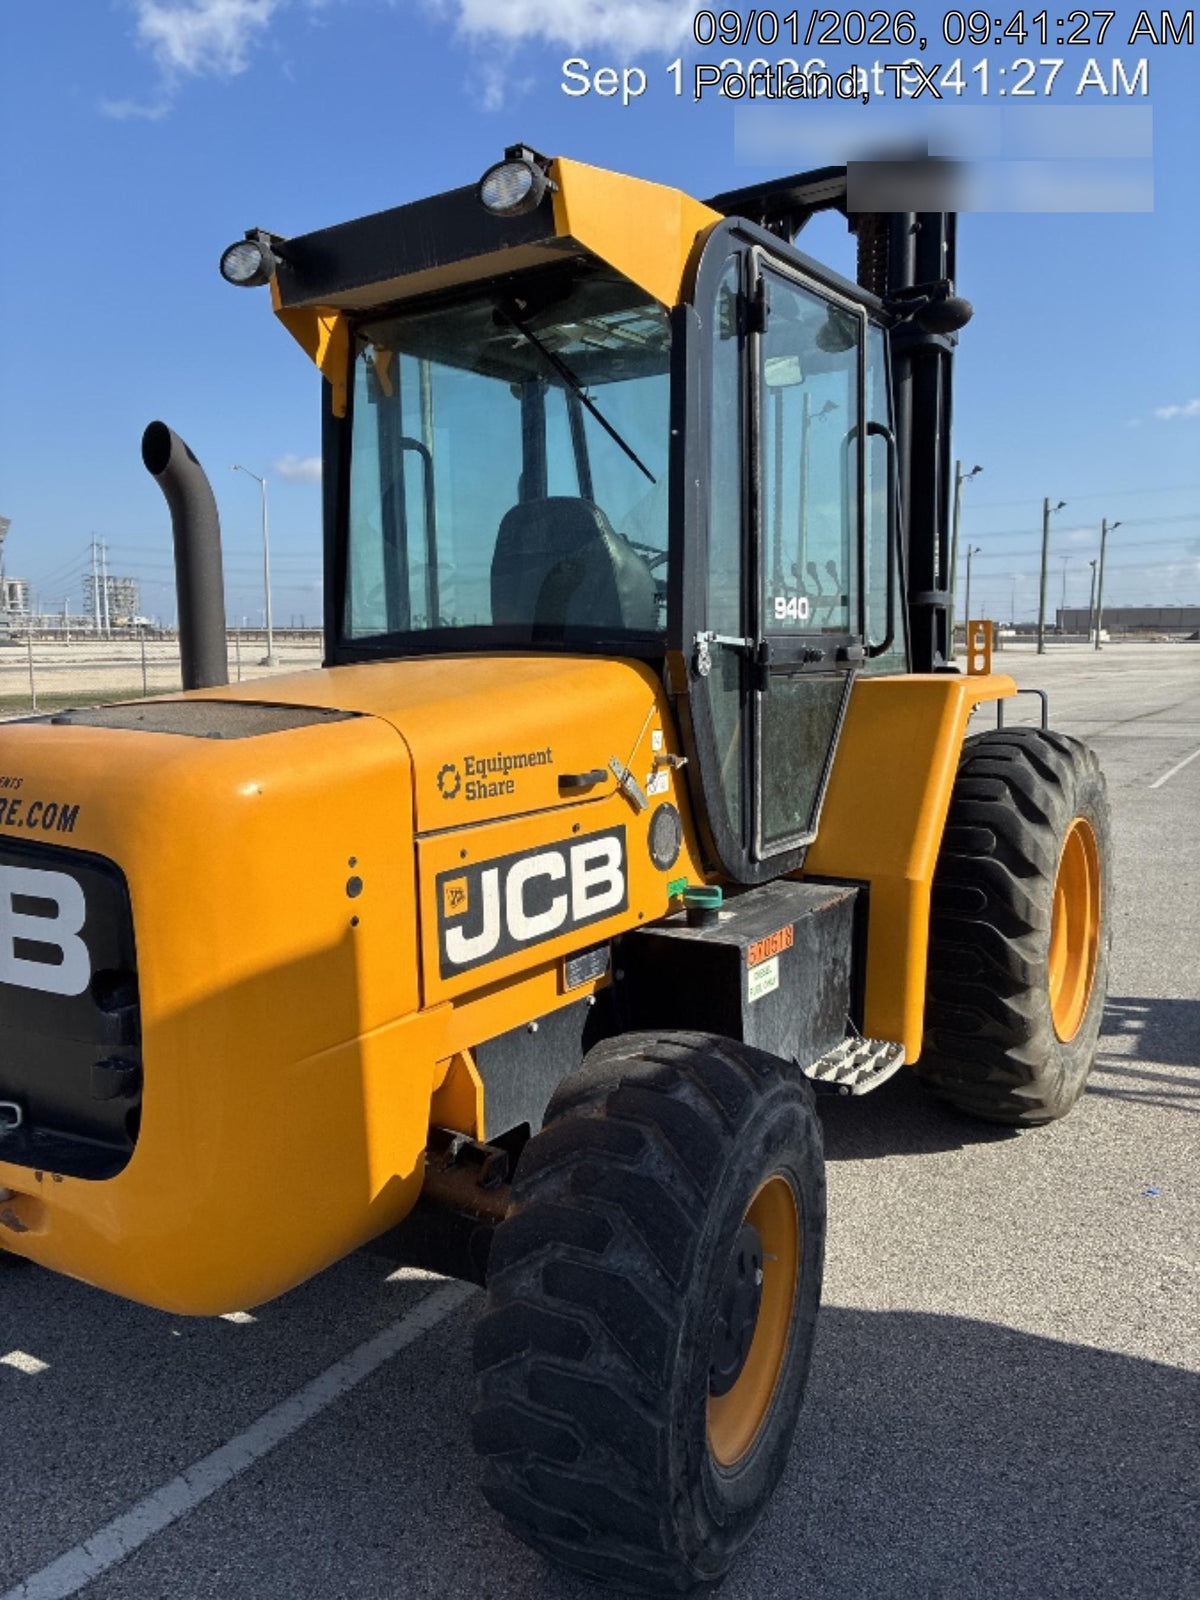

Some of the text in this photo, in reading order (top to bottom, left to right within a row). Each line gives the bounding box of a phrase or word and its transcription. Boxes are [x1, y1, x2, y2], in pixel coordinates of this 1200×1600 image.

[774, 596, 809, 620] 940
[464, 747, 553, 779] Equipment
[465, 779, 515, 801] Share
[445, 836, 625, 964] JCB
[0, 864, 92, 996] B
